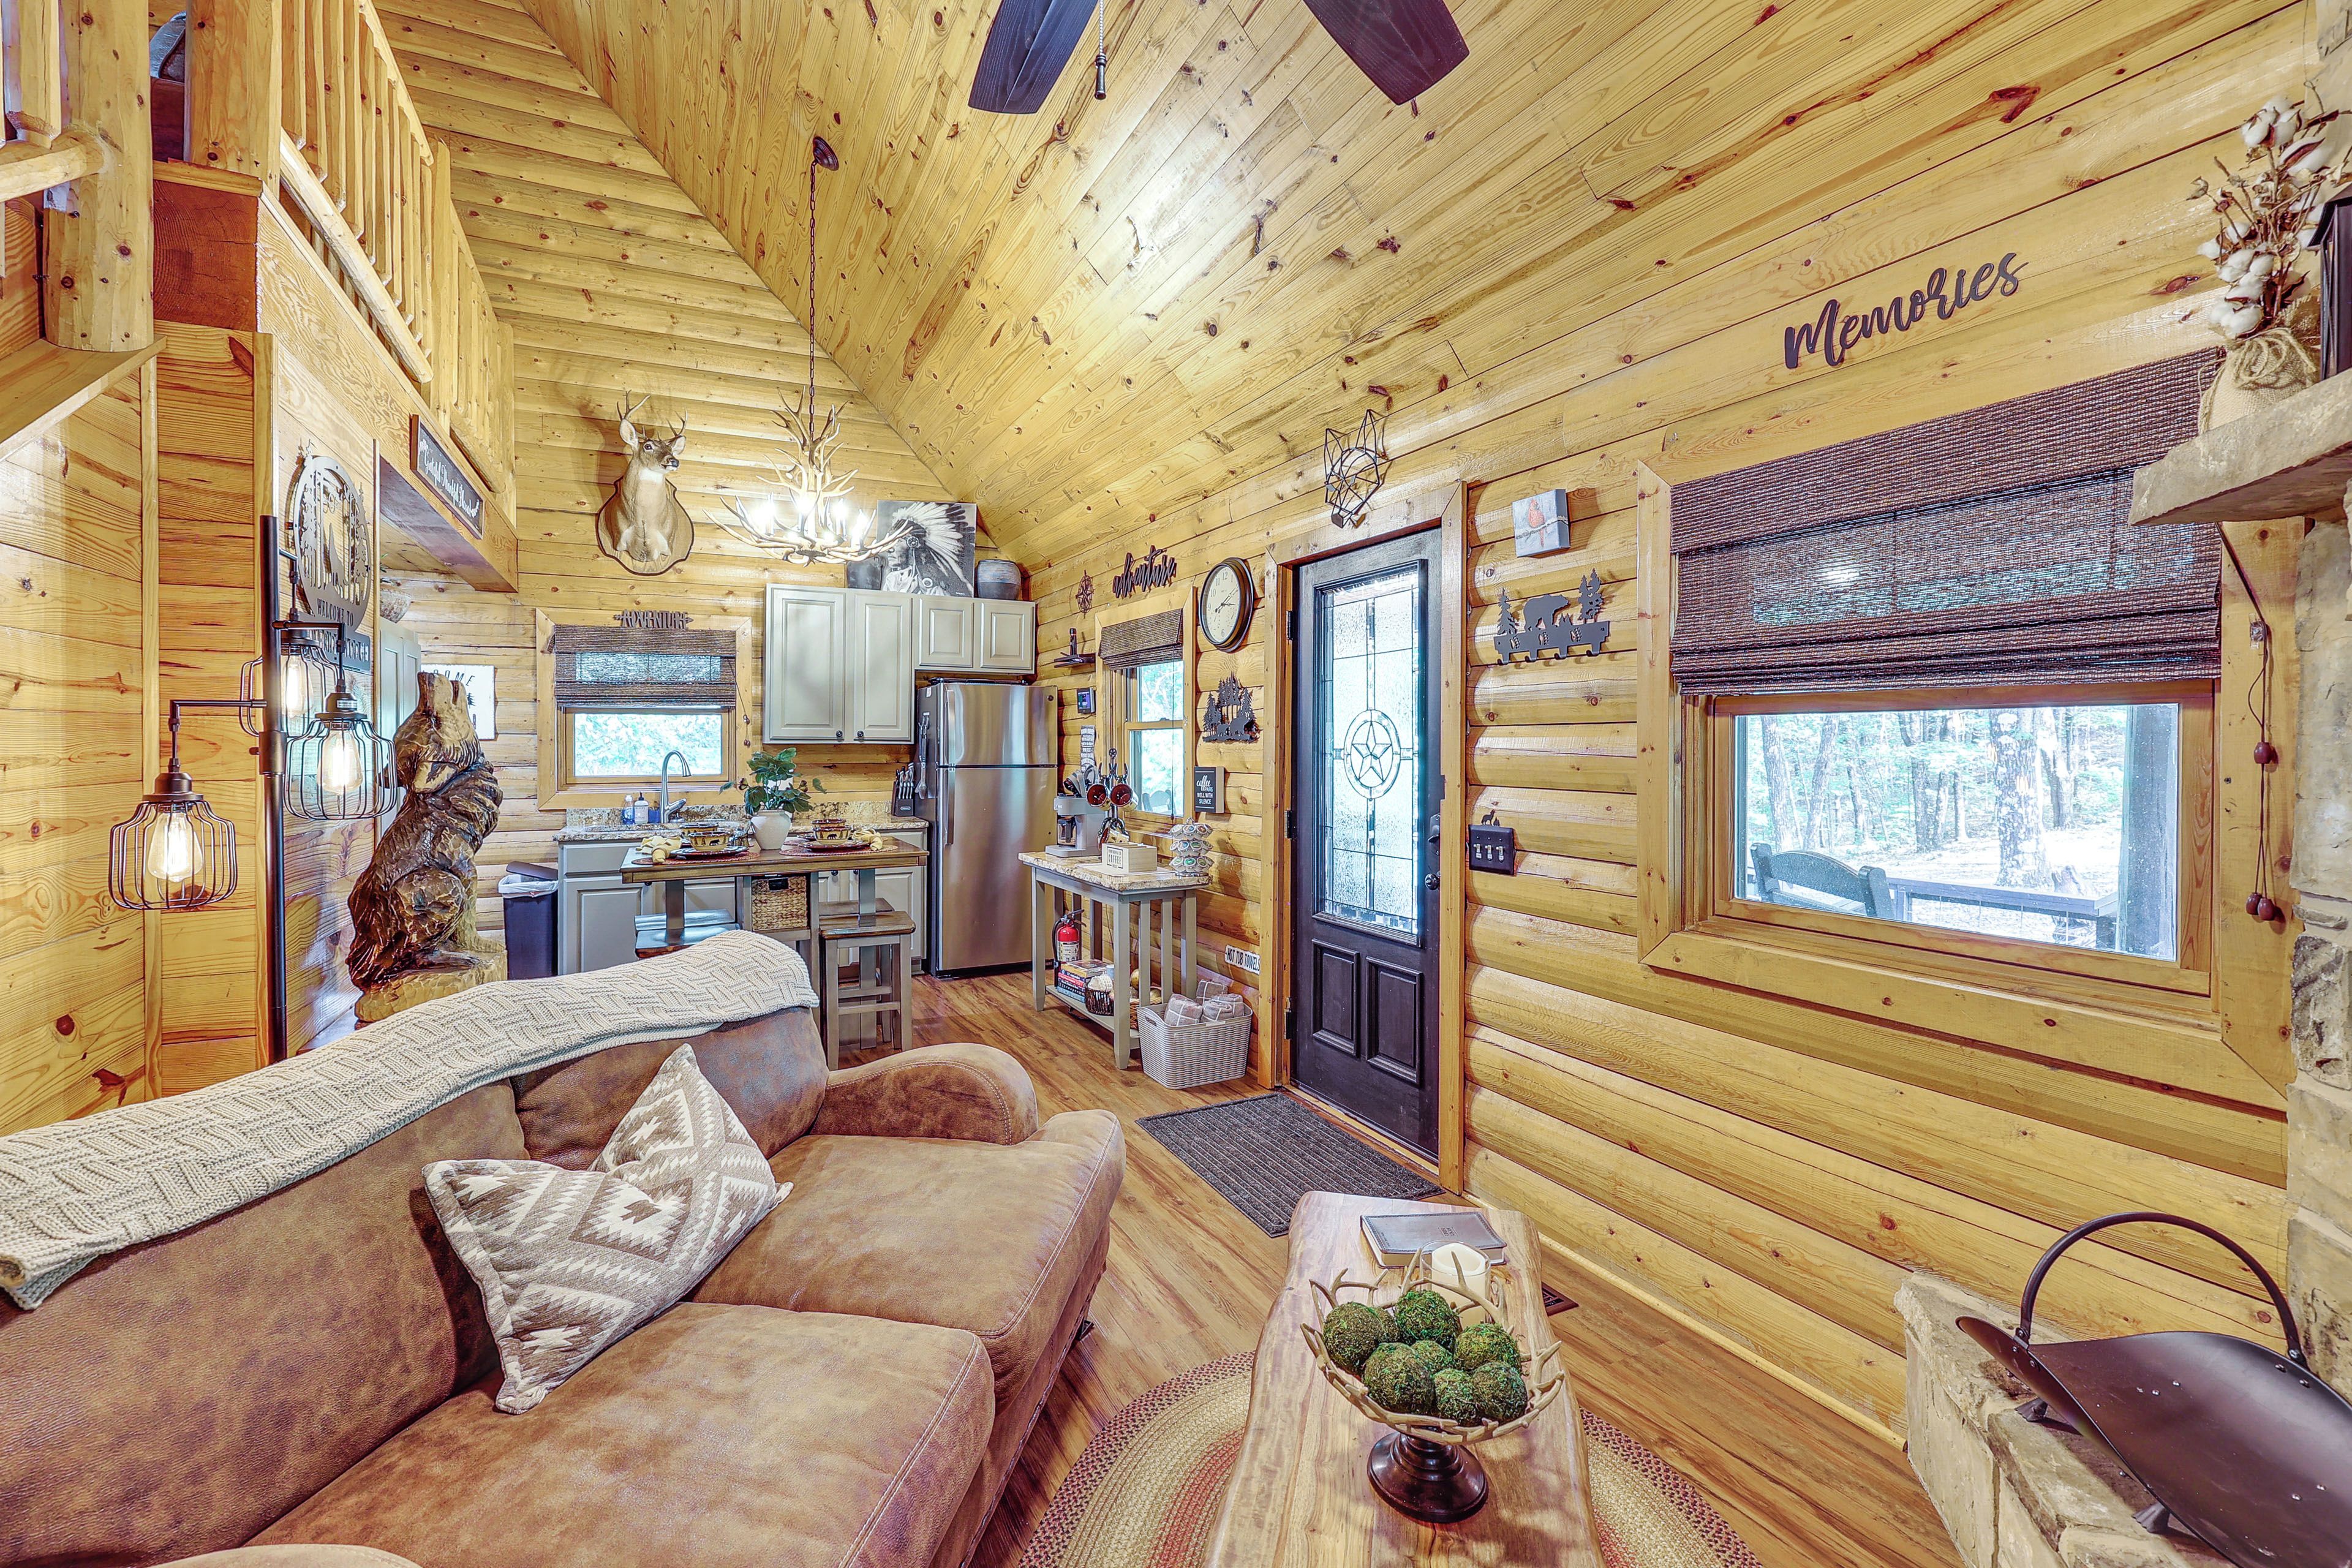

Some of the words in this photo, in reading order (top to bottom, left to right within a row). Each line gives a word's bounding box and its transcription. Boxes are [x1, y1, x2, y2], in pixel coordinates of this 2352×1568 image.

[1784, 252, 2029, 369] Memories
[1223, 571, 1228, 581] 12
[1216, 578, 1220, 586] 11
[1210, 588, 1216, 597] 10
[317, 598, 345, 624] WELCOME
[347, 610, 354, 627] TO
[1208, 603, 1212, 611] 9
[620, 609, 688, 630] ADVENTURE
[1221, 628, 1225, 637] 6
[1196, 775, 1211, 791] coffee
[1108, 854, 1121, 865] COFFEE
[1227, 948, 1235, 962] HOT
[1244, 954, 1260, 971] TOWELS
